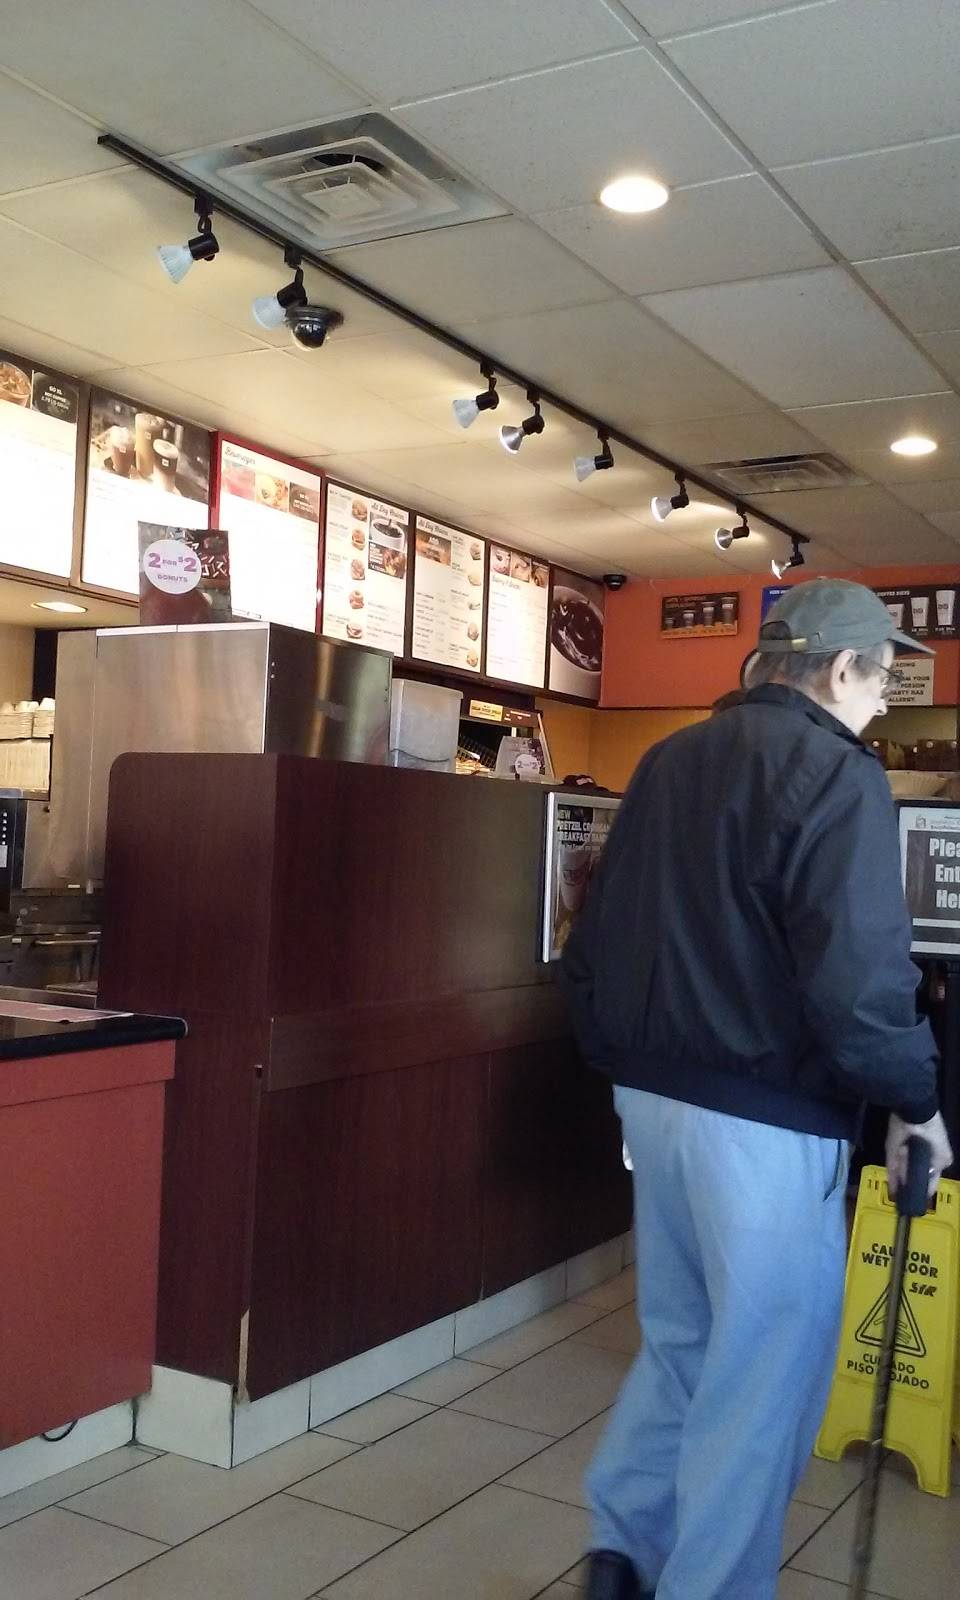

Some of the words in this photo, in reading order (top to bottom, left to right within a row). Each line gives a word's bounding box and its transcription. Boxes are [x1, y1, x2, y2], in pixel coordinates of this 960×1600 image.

[148, 552, 161, 569] 2
[157, 574, 188, 583] DONUTS
[862, 1252, 890, 1268] WET
[847, 1359, 875, 1375] PISO
[876, 1368, 930, 1390] OJADO
